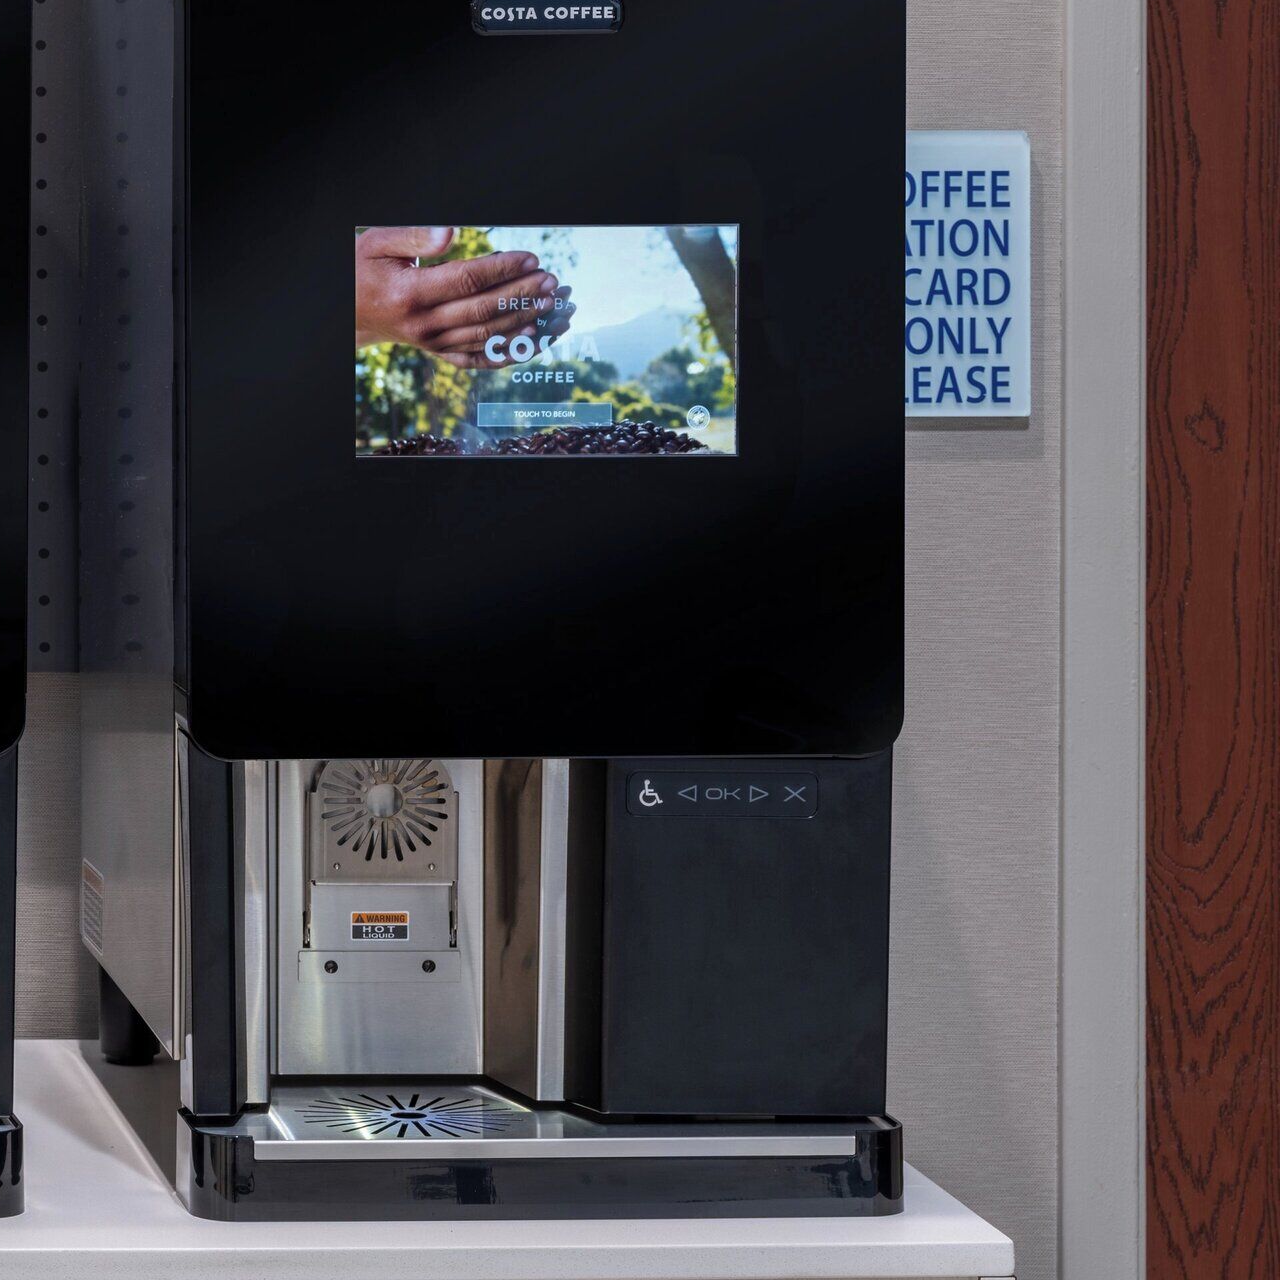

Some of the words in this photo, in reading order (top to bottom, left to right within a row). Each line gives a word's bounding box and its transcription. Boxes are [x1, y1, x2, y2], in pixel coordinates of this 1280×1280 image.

[481, 7, 538, 21] COSTA
[544, 6, 614, 19] COFFEE
[905, 218, 1010, 257] TION
[905, 268, 1011, 306] CARD
[498, 298, 547, 310] BREW
[554, 298, 576, 310] BA
[537, 318, 547, 327] by
[905, 316, 1012, 354] ONLY
[485, 335, 600, 366] COSTA
[512, 372, 574, 383] COFFEE
[905, 366, 1011, 404] EASE
[514, 410, 539, 418] TOUCH
[705, 788, 740, 800] OK
[367, 914, 405, 923] WARNING
